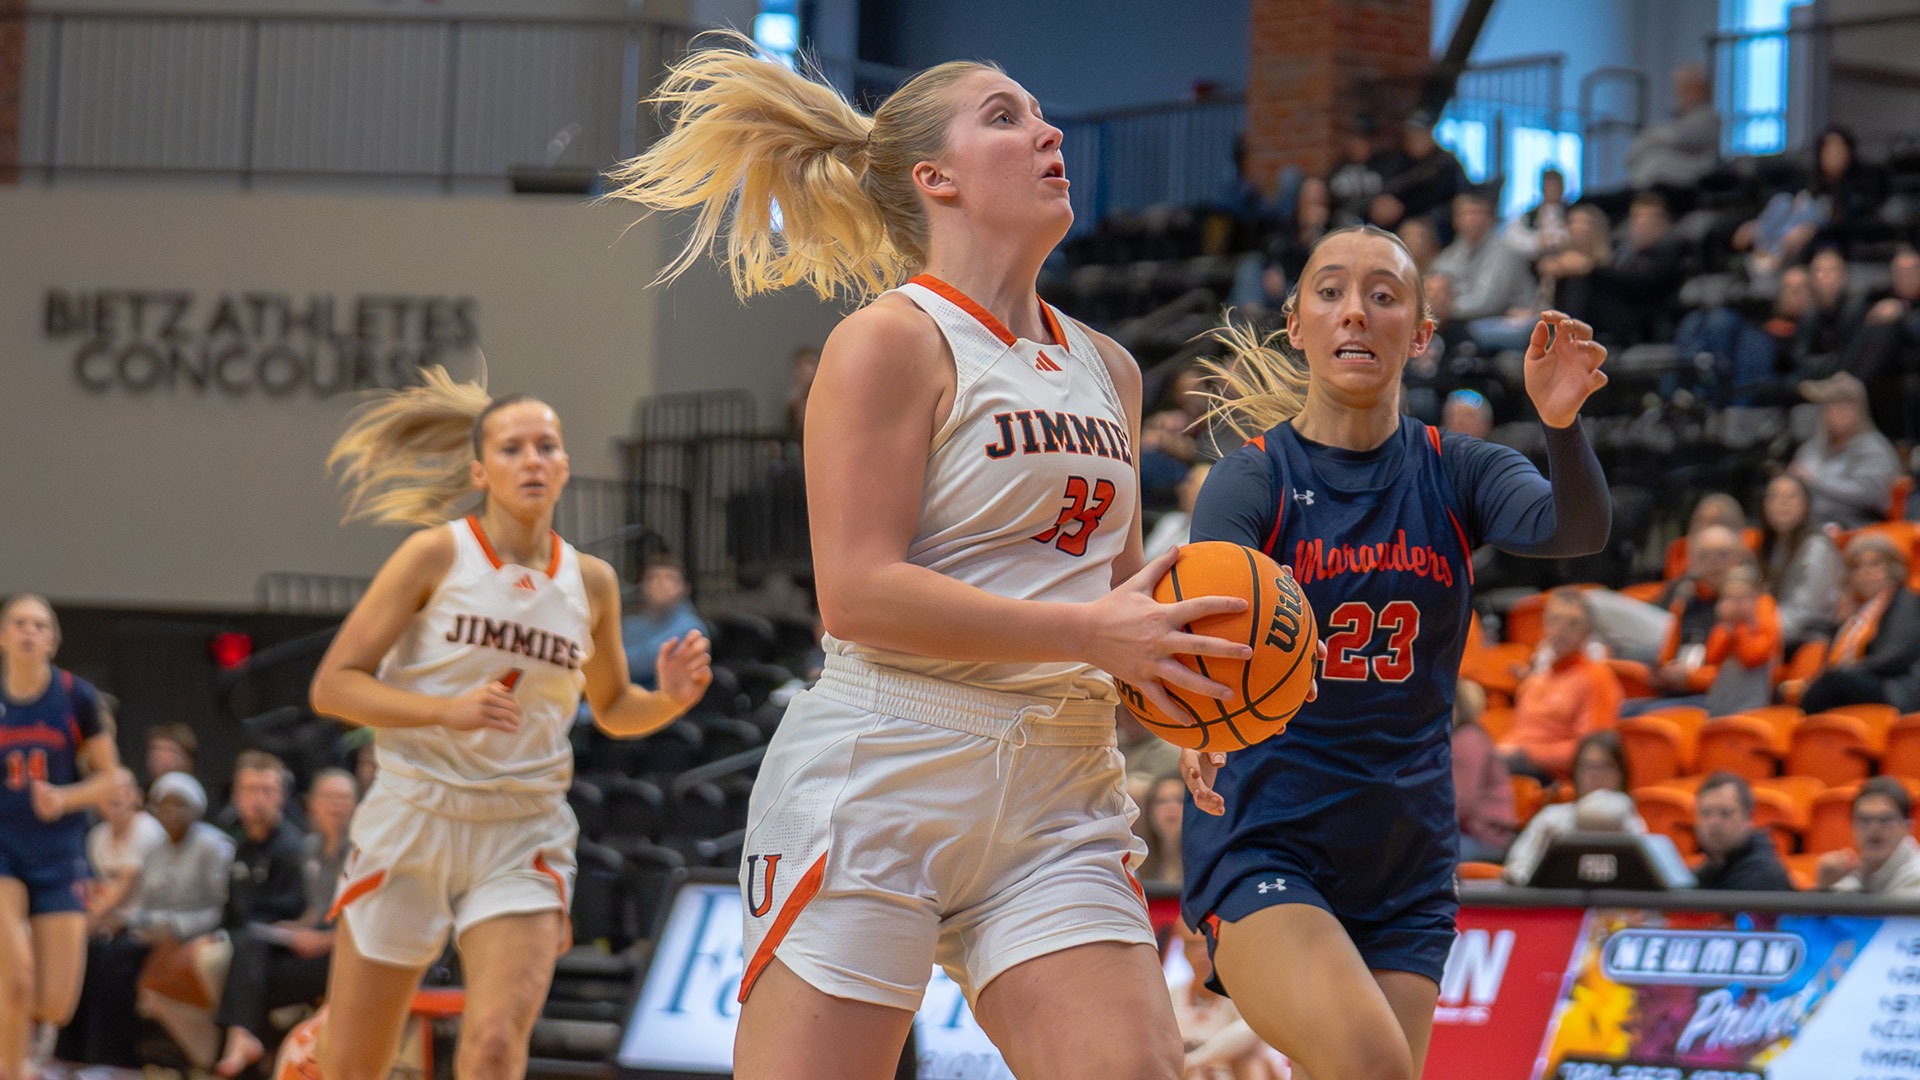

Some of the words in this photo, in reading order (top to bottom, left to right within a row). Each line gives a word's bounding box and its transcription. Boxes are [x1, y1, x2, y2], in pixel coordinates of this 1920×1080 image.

[43, 286, 191, 340] BIETZ
[206, 291, 480, 348] ATHLETES
[1294, 529, 1453, 588] Marauders
[446, 613, 582, 670] JIMMIES
[1322, 600, 1420, 682] 23
[1611, 934, 1797, 975] NEWMAN
